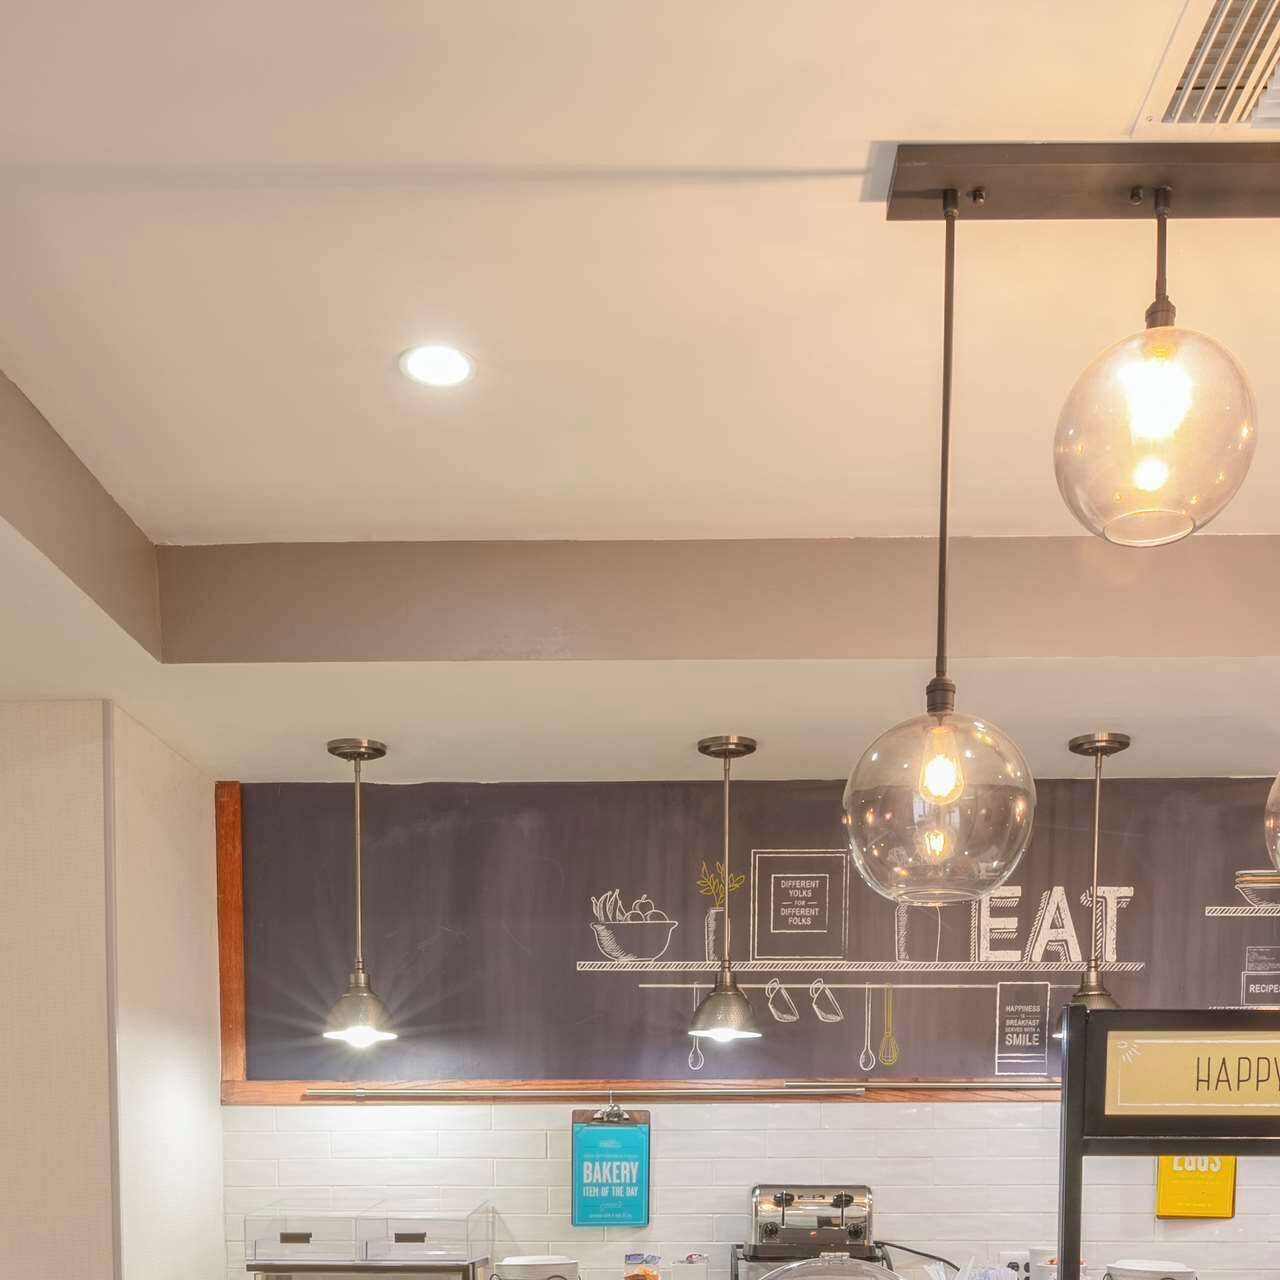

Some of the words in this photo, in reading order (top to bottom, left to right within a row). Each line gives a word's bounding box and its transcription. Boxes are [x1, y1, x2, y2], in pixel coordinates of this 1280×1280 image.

[780, 880, 819, 888] DIFFERENT
[789, 889, 812, 897] YOLKS
[780, 907, 819, 916] DIFFERENT
[788, 917, 812, 925] FOLKS
[972, 885, 1134, 963] EAT
[1005, 1033, 1040, 1046] SMILE
[582, 1161, 639, 1184] BAKERY
[583, 1186, 599, 1197] ITEM
[601, 1186, 610, 1196] OF
[612, 1186, 624, 1197] THE
[626, 1186, 639, 1197] DAY
